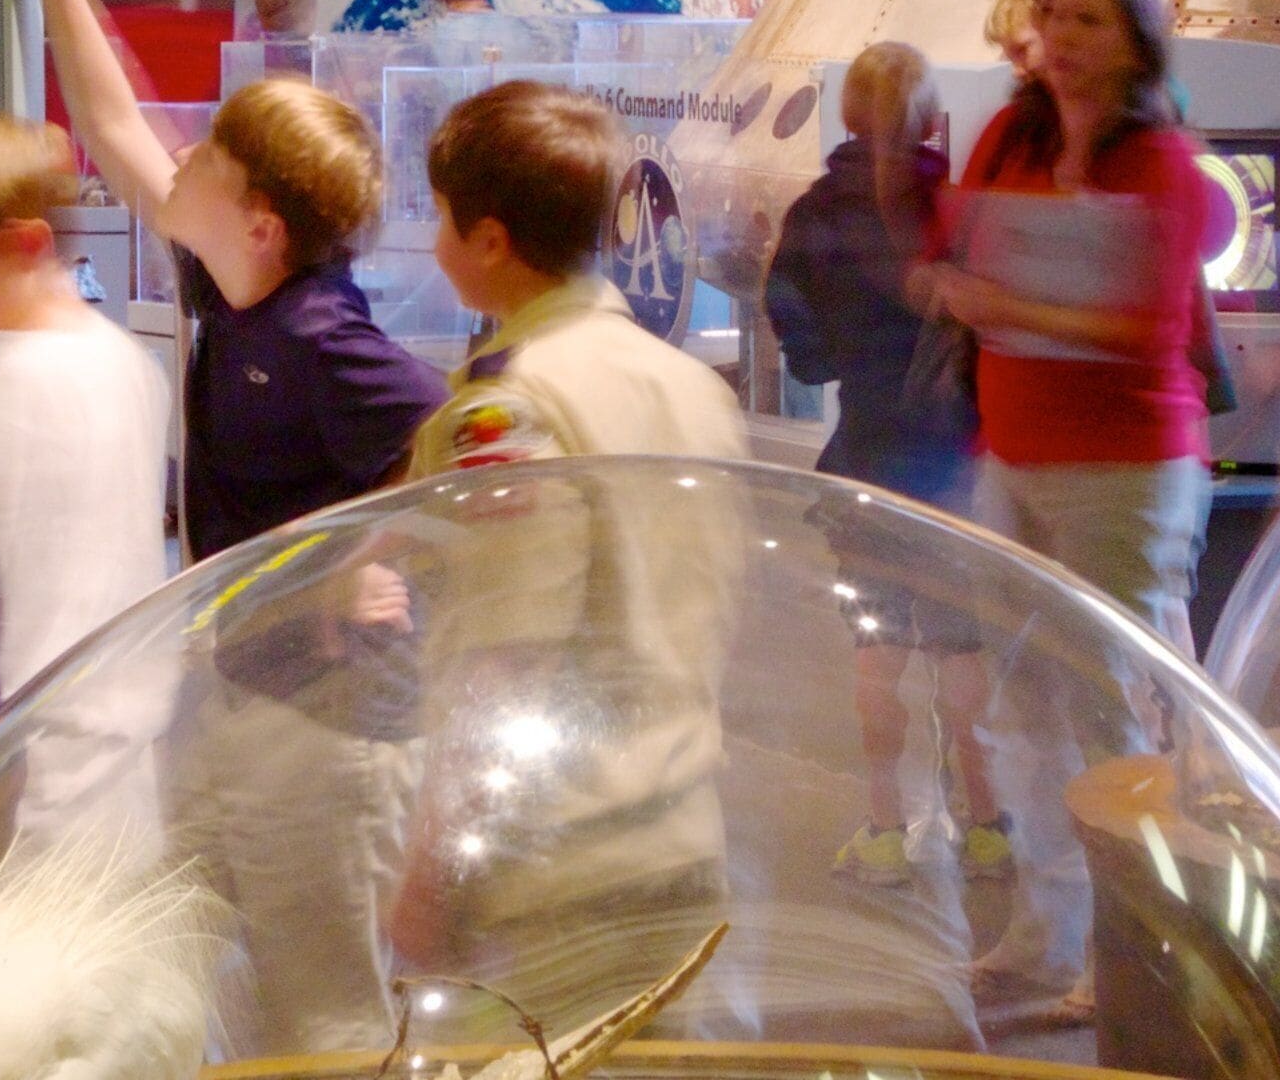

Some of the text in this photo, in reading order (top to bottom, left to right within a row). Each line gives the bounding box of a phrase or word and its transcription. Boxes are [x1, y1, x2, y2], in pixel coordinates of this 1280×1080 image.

[616, 87, 685, 119] Command
[688, 92, 742, 124] Module
[621, 133, 683, 194] POLLO
